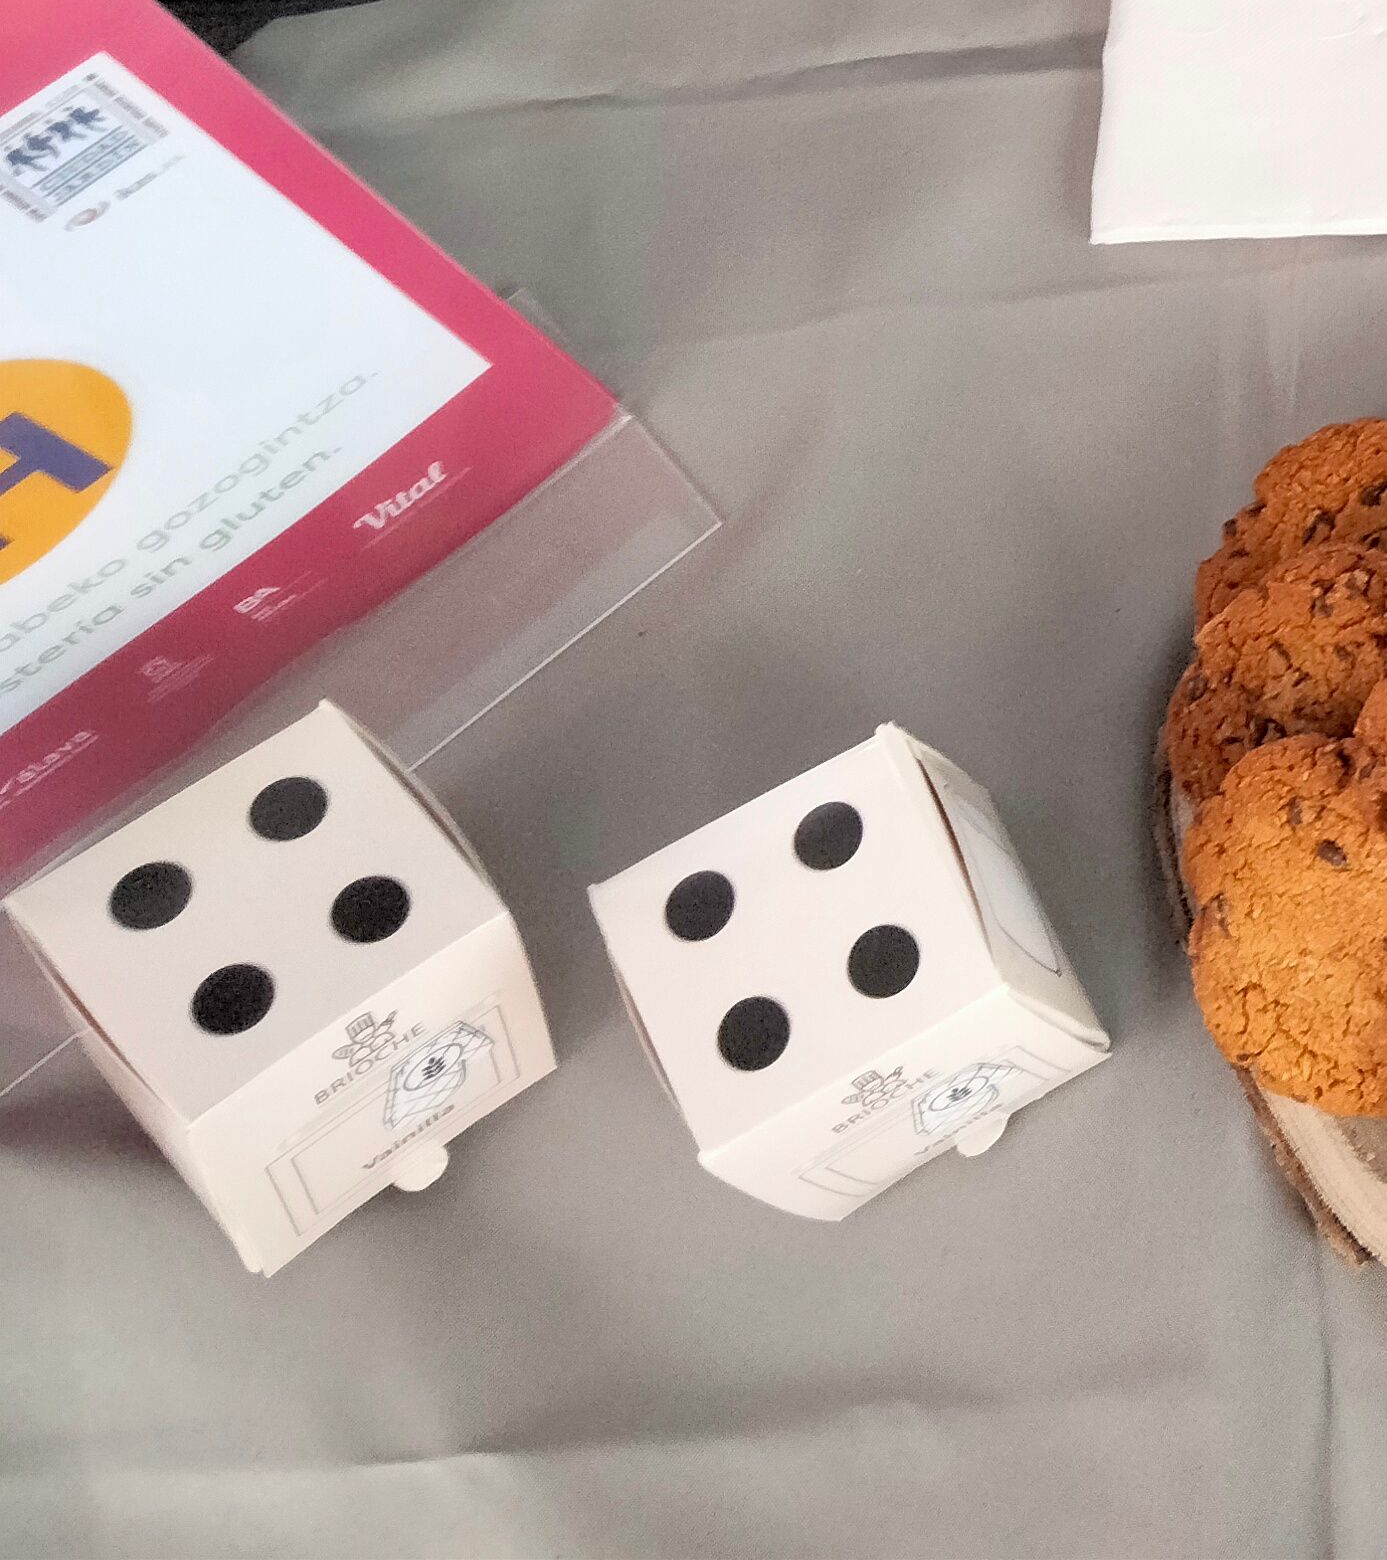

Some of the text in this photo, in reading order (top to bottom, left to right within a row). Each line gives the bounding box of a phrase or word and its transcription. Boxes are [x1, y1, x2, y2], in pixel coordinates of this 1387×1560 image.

[353, 460, 449, 530] Vital
[130, 556, 192, 599] sin
[313, 1022, 429, 1106] BRIOCHE
[831, 1069, 937, 1134] BRIOCHE
